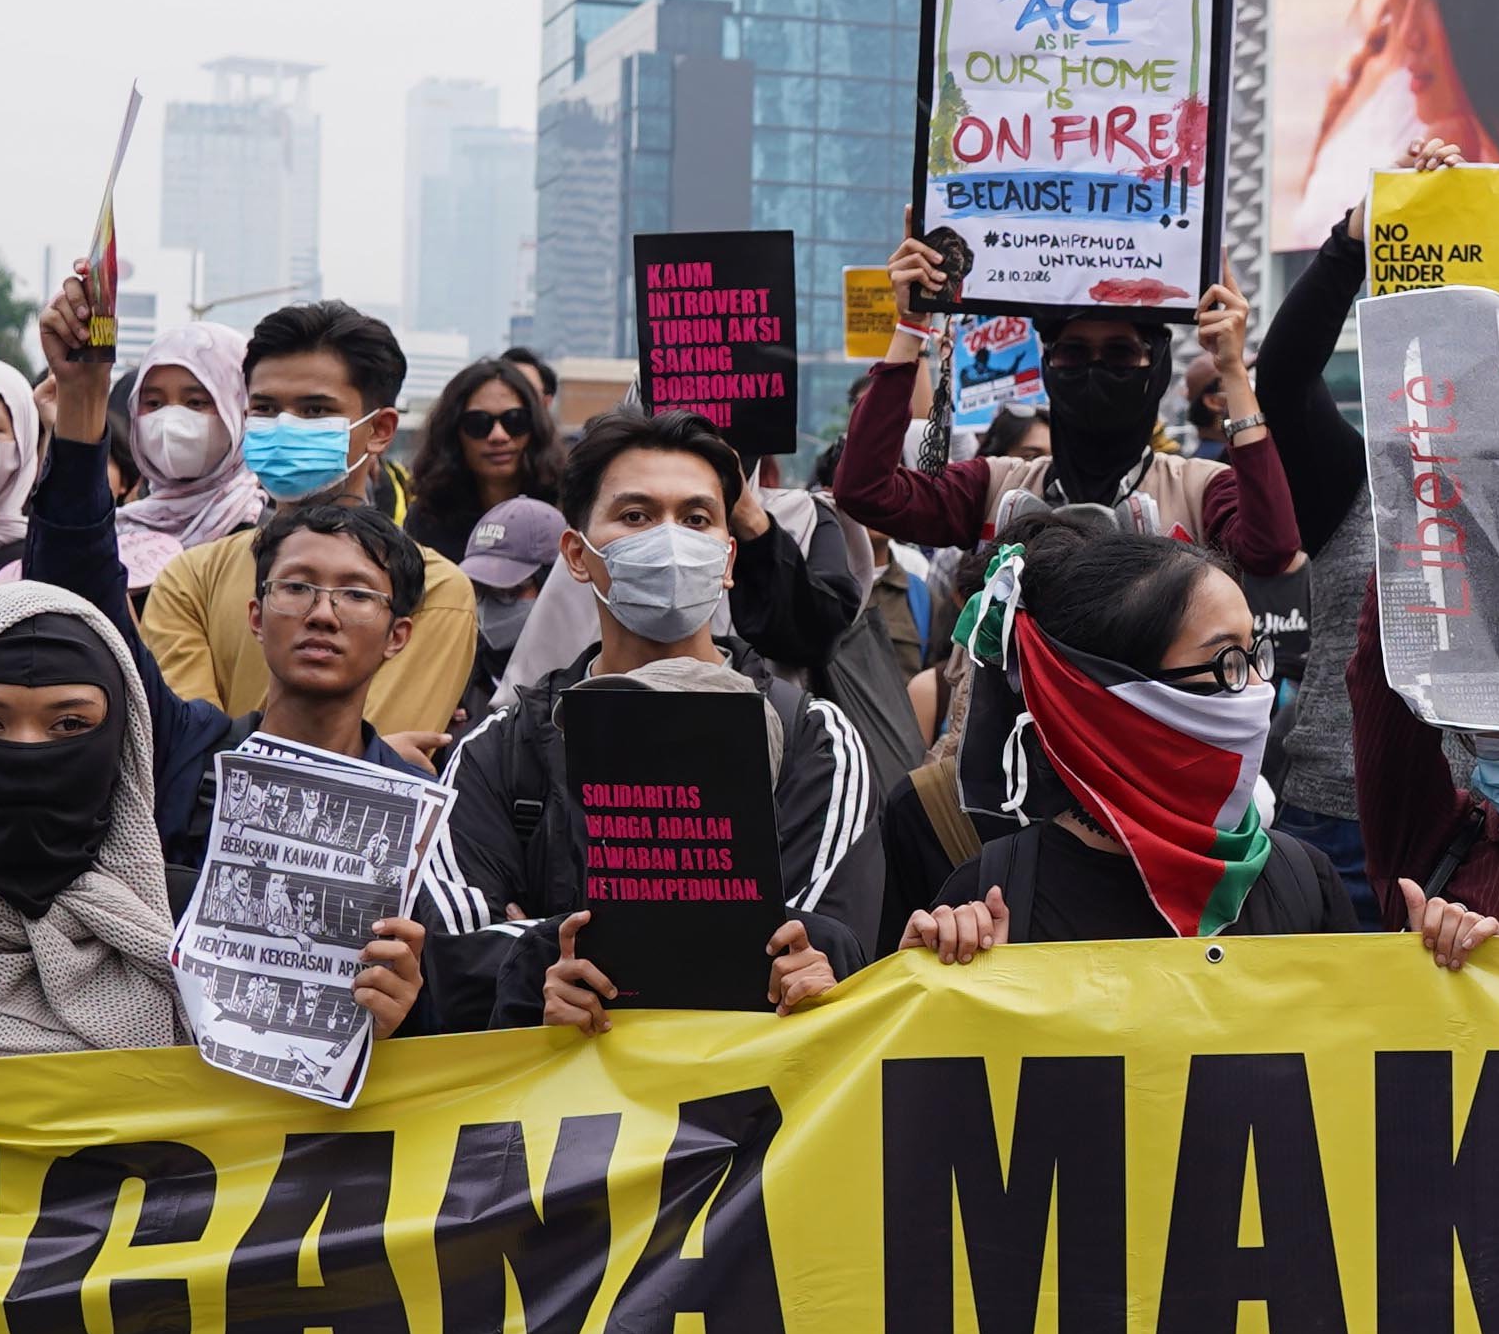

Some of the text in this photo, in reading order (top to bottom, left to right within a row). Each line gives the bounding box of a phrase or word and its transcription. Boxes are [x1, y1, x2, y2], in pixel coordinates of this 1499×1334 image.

[1035, 34, 1080, 51] AS IF
[965, 51, 1178, 93] OUR HOME
[1047, 87, 1074, 110] IS
[952, 106, 1173, 164] ON FIRE
[946, 180, 1072, 213] BECAUSE
[1087, 182, 1118, 212] IT
[984, 230, 1135, 250] #SUMPAHPEMUDA
[1375, 223, 1408, 241] NO
[1374, 244, 1483, 262] CLEAN AIR
[646, 262, 713, 288] KAUM
[1375, 264, 1445, 282] UNDER
[648, 288, 770, 317] INTROVERT
[649, 316, 781, 346] TURUN AKSI
[651, 345, 732, 373] SAKING
[652, 373, 784, 401] BOBROKNYA
[582, 783, 701, 809] SOLIDARITAS
[585, 814, 732, 840] WARGA ADALAH
[220, 835, 279, 862] BEBASKAN
[282, 842, 329, 868] KAWAN
[587, 846, 733, 871] JAWABAN ATAS
[587, 876, 763, 901] KETIDAKPEDULIAN.
[195, 935, 257, 962] HENTIKAN
[259, 945, 335, 973] KEKERASAN
